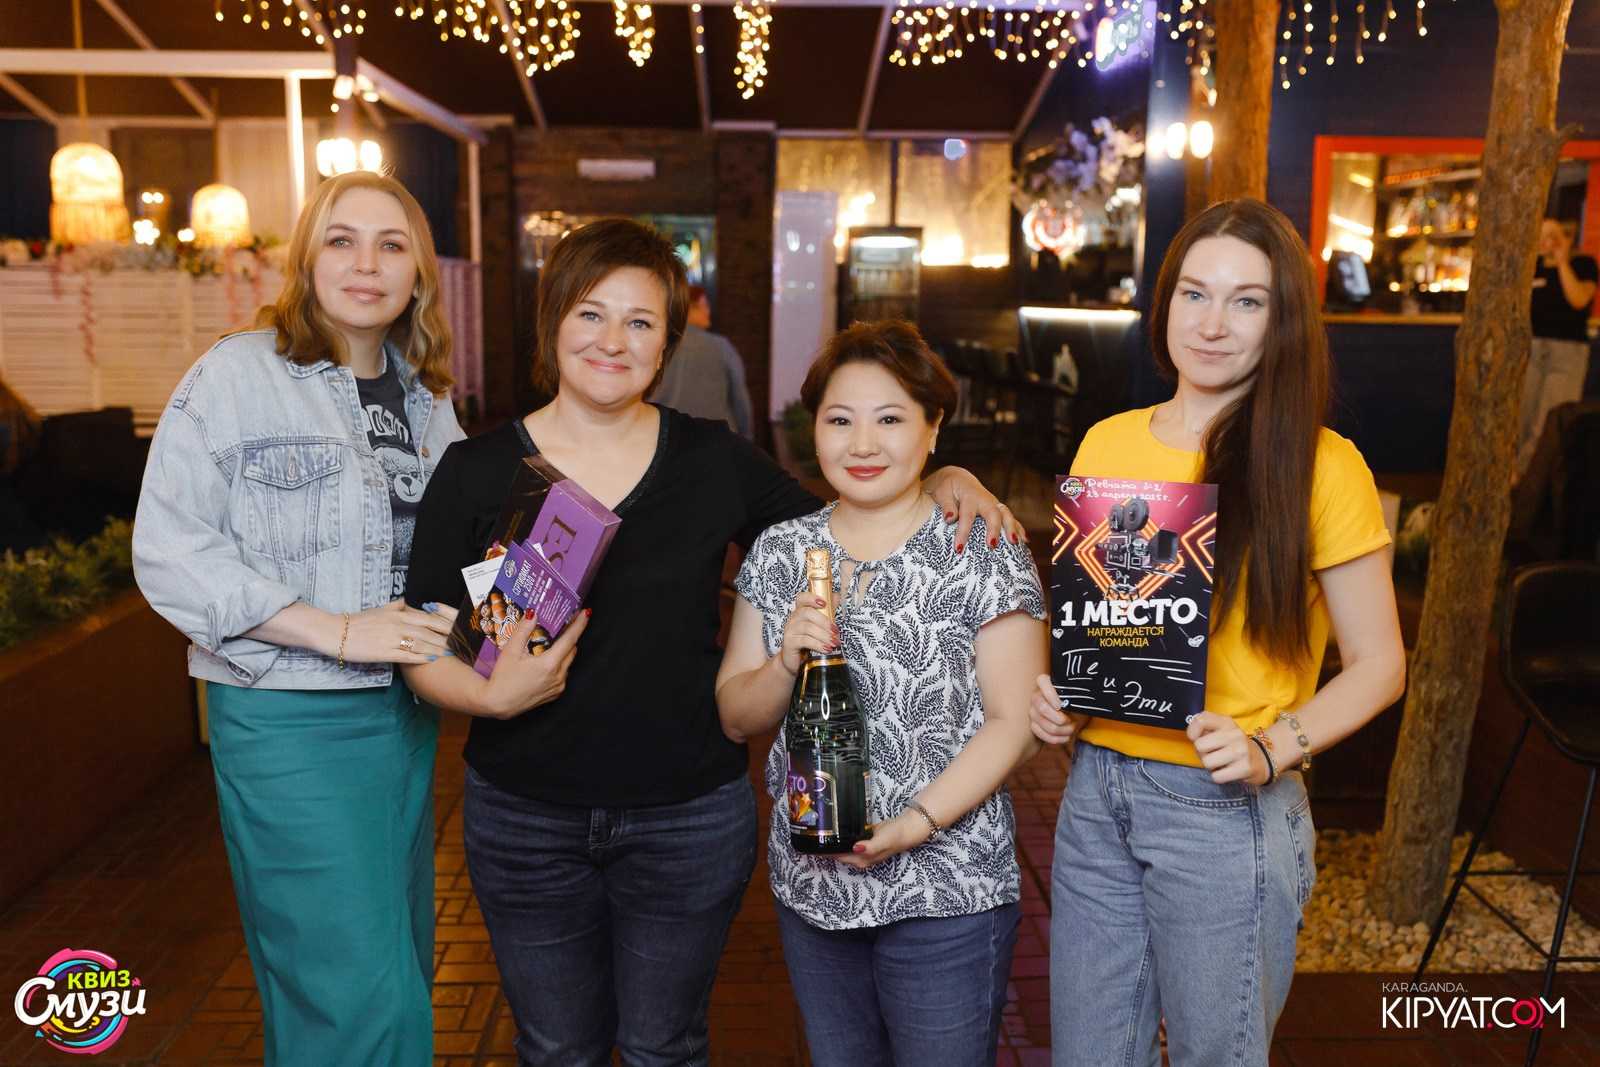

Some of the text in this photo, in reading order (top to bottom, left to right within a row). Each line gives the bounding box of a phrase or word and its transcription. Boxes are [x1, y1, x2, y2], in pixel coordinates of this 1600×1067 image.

[1060, 597, 1198, 627] 1 МЕСТО
[1087, 626, 1165, 637] НАГРАЖДАЕТСЯ
[1099, 638, 1150, 647] КОМАНДА
